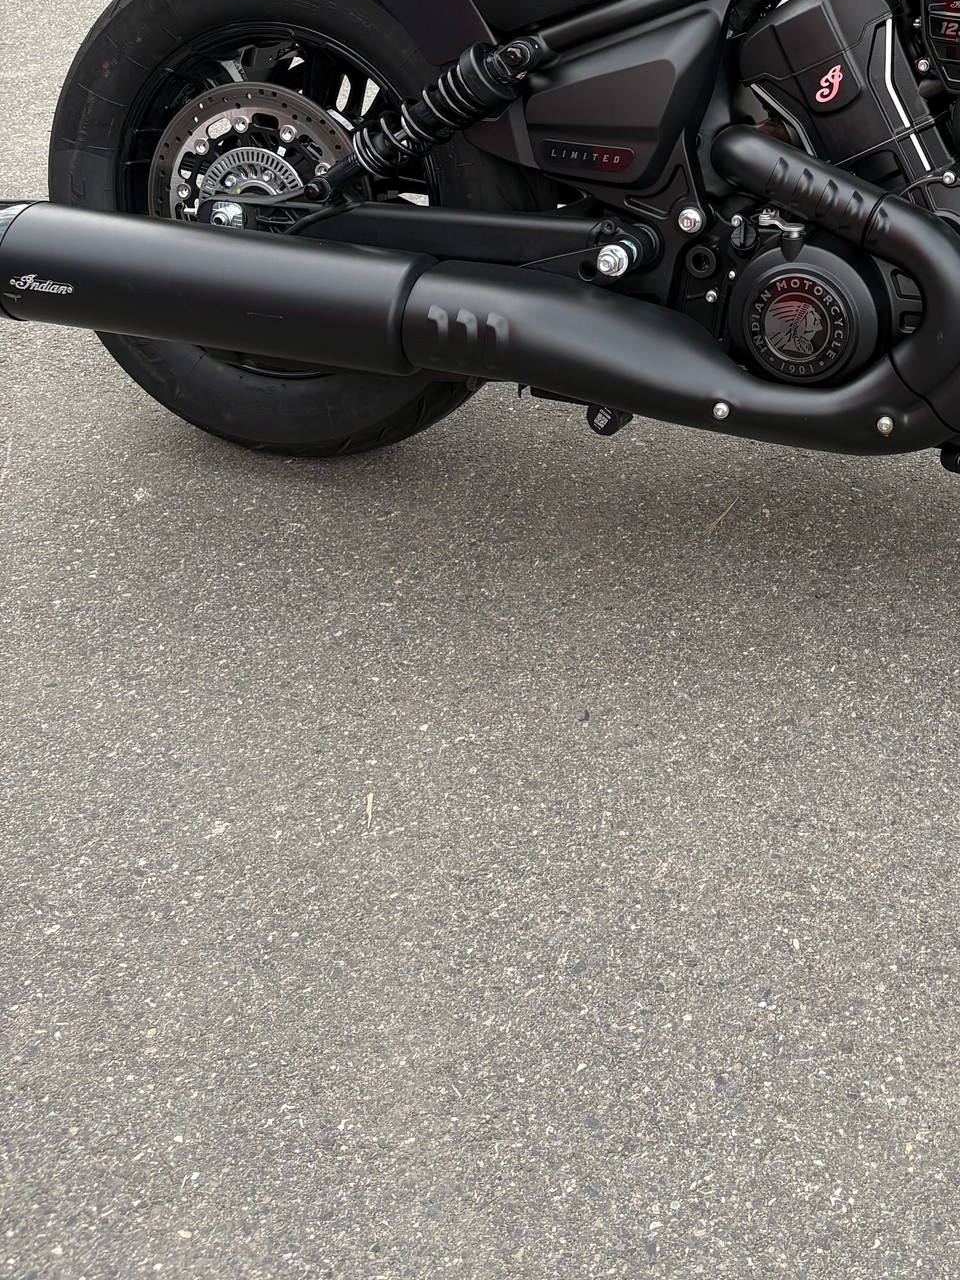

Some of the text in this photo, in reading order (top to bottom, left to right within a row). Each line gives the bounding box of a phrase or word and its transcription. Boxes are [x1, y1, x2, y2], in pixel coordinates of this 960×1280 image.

[551, 149, 621, 164] LIMITED
[15, 274, 69, 295] Indian
[751, 278, 844, 360] INDIAN MOTORCYCLE
[780, 362, 816, 376] 1901
